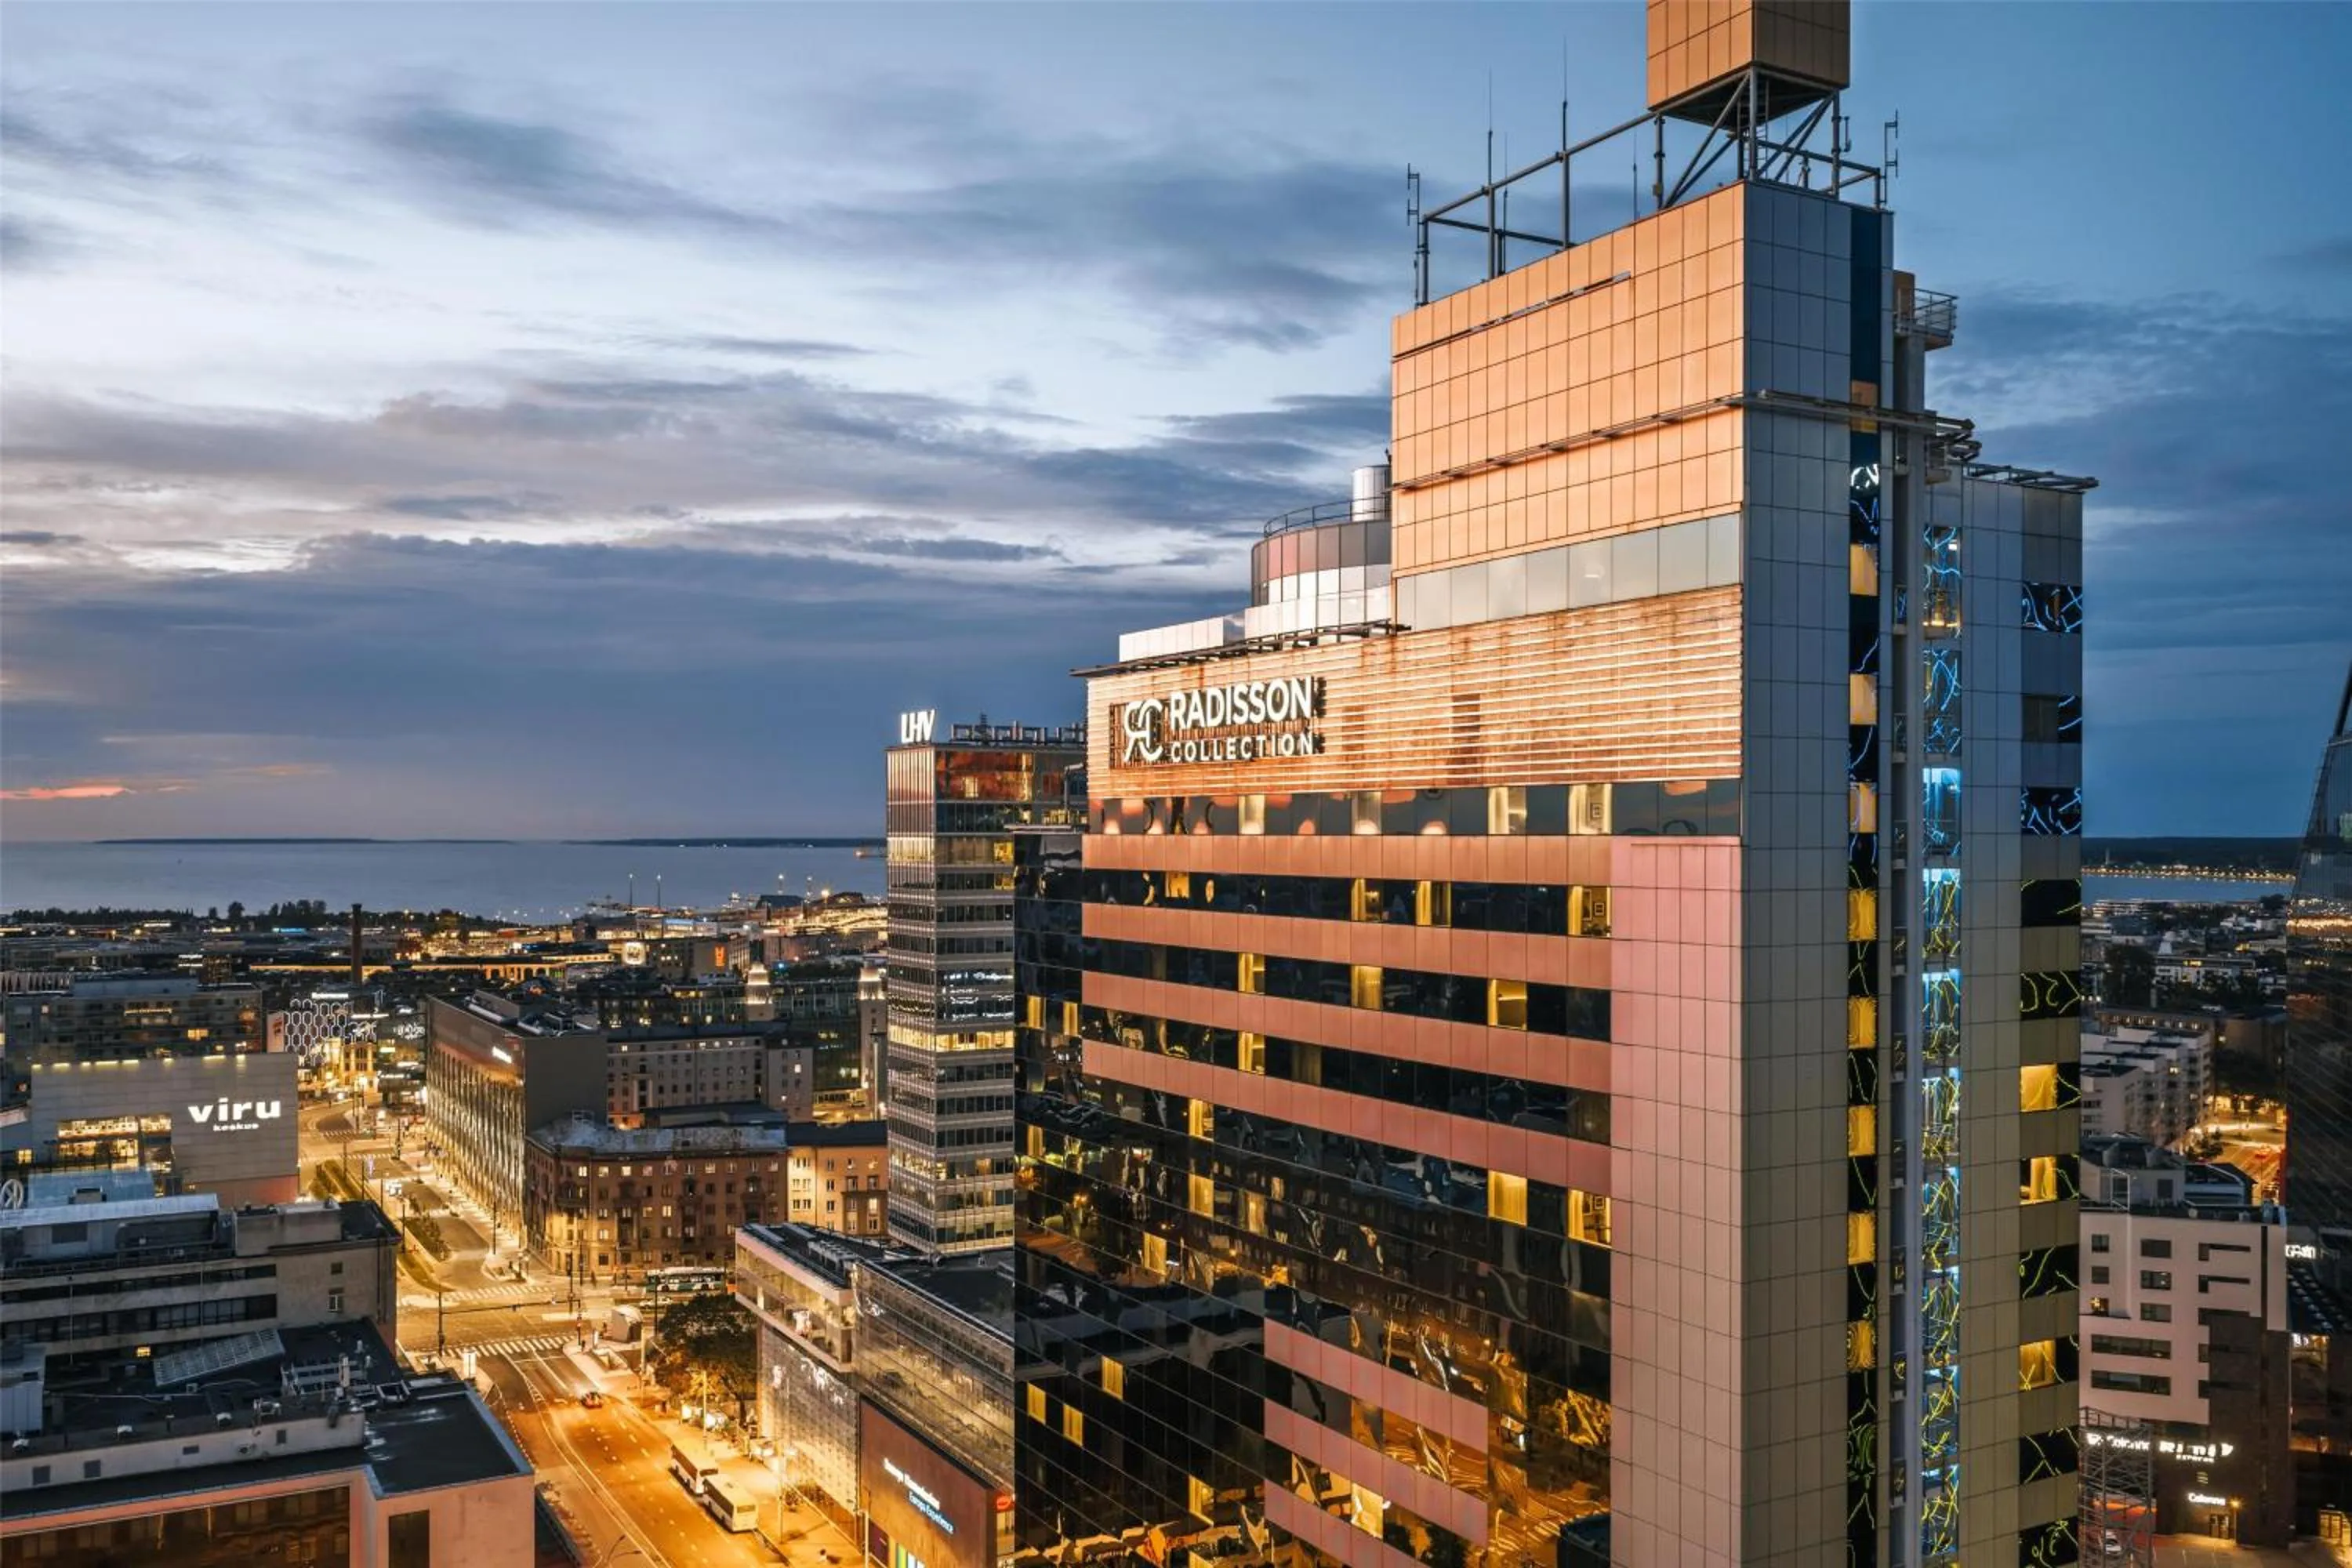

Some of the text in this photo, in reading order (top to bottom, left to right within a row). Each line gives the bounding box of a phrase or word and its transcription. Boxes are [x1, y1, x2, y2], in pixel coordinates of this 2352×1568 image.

[1170, 675, 1312, 731] RADISSON
[901, 708, 935, 743] LHV
[1171, 730, 1314, 763] COLLECTION
[187, 1097, 281, 1123] viru
